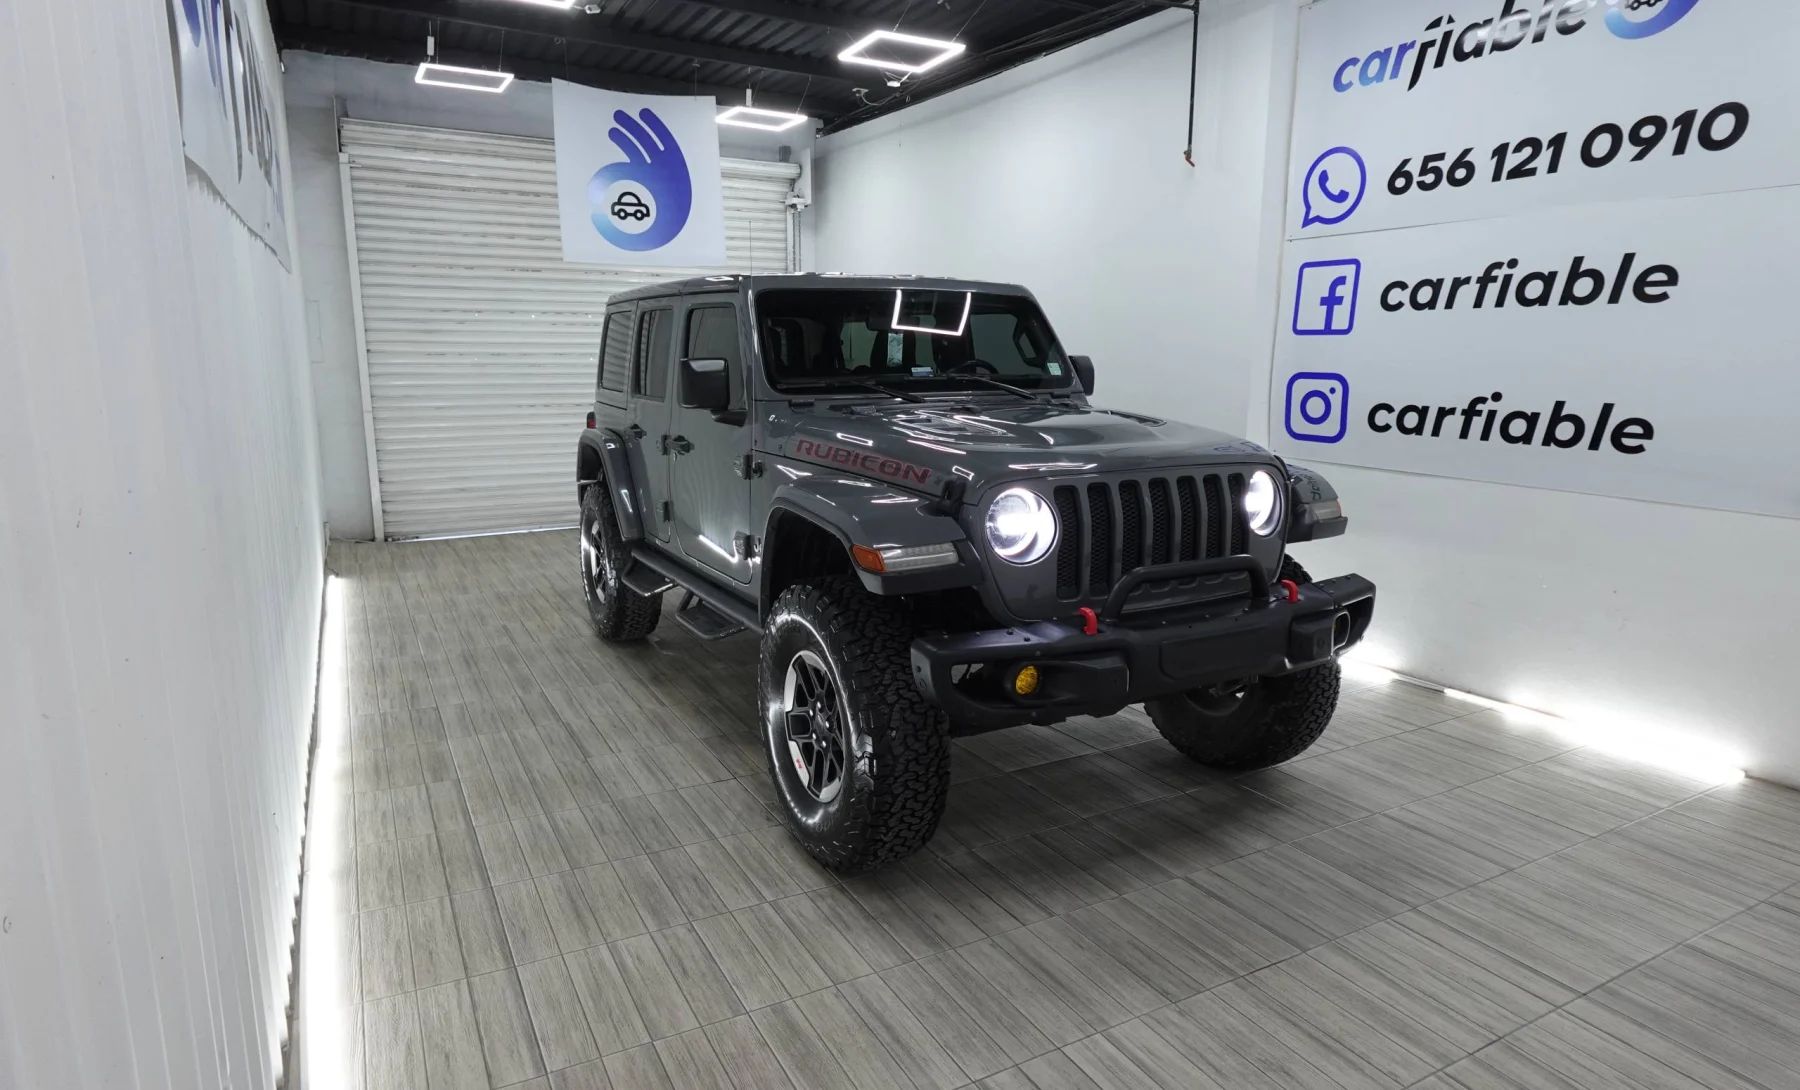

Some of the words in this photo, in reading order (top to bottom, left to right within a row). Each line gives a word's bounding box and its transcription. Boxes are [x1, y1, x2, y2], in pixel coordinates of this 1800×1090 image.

[1332, 0, 1597, 93] carfiable
[1387, 147, 1476, 196] 656
[1490, 131, 1568, 183] 121
[1580, 101, 1750, 169] 0910
[1379, 252, 1680, 313] carfiable
[1367, 391, 1655, 455] carfiable
[795, 438, 933, 485] RUBICON
